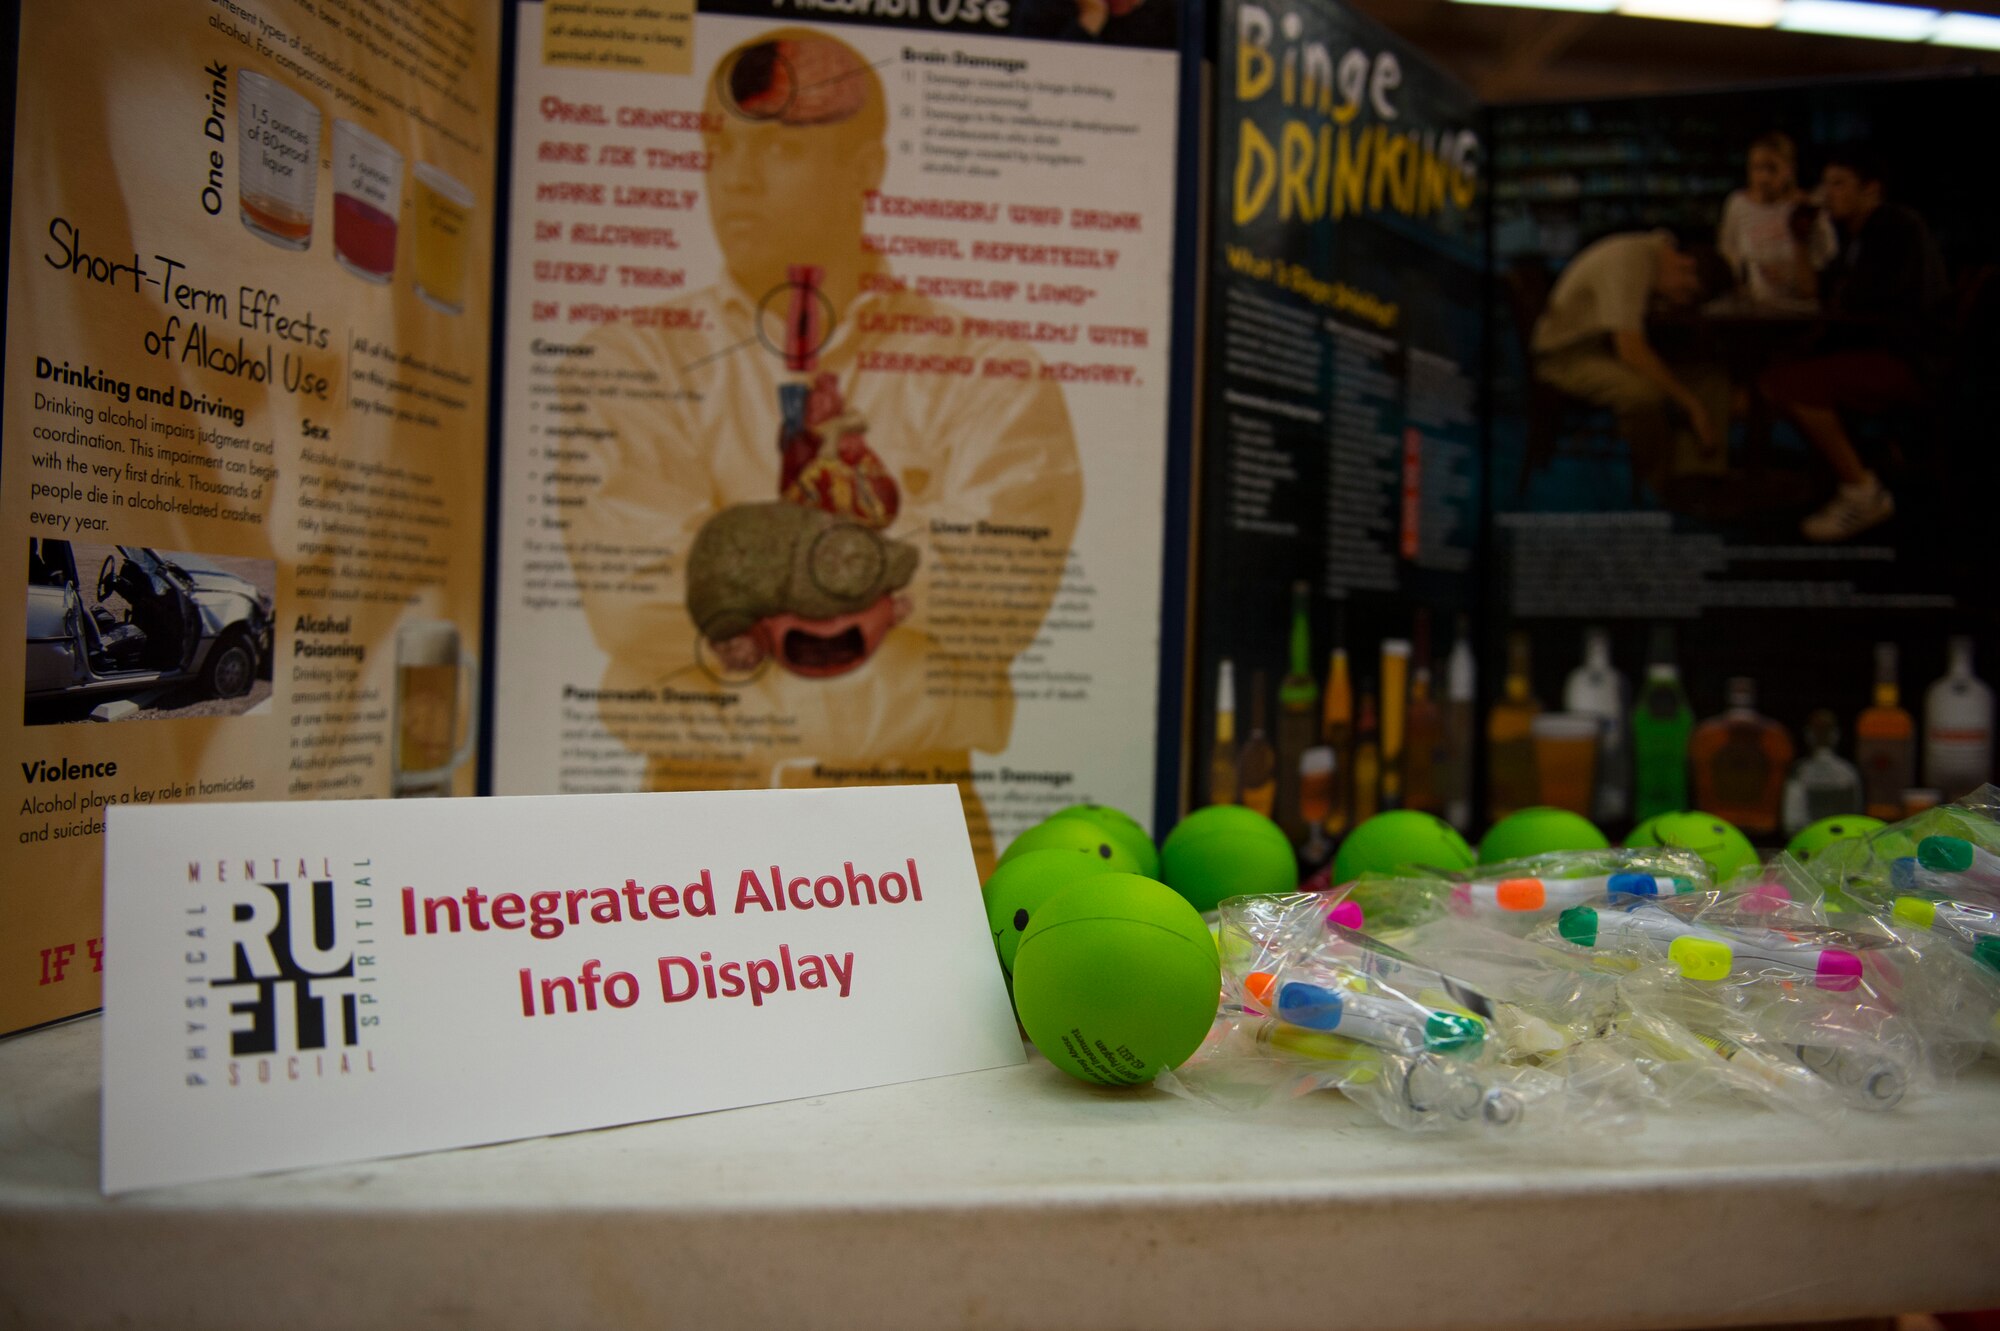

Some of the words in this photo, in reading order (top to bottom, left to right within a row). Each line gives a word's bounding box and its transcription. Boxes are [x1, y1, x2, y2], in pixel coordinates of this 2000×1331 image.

[208, 13, 254, 49] alcohol.
[256, 38, 274, 59] For
[276, 53, 333, 92] comparison
[259, 17, 287, 44] types
[901, 47, 947, 65] Brain
[953, 50, 1028, 73] Damage
[1236, 3, 1404, 125] Binge
[204, 59, 228, 144] Drink
[248, 127, 261, 143] of
[251, 104, 268, 125] 1.5
[270, 118, 311, 146] ounces
[202, 149, 224, 216] One
[261, 152, 294, 179] liquor
[1232, 116, 1480, 228] DRINKING
[44, 216, 228, 320] Short-Term
[238, 286, 331, 350] Effects
[144, 316, 181, 361] of
[181, 321, 274, 386] Alcohol
[283, 351, 329, 401] Use
[530, 337, 596, 357] Cancer
[35, 355, 131, 403] Drinking
[135, 385, 175, 407] and
[179, 390, 246, 427] Driving
[34, 391, 94, 425] Drinking
[98, 406, 148, 431] alcohol
[150, 417, 196, 440] impairs
[197, 426, 250, 453] judgment
[252, 438, 274, 456] and
[301, 417, 331, 442] Sex
[31, 451, 62, 471] with
[66, 453, 88, 475] the
[92, 462, 122, 484] very
[125, 463, 148, 483] first
[150, 468, 185, 488] drink.
[188, 474, 249, 500] Thousands
[251, 485, 264, 501] of
[32, 426, 126, 454] coordination.
[129, 437, 154, 459] This
[156, 442, 223, 470] impairment
[225, 459, 247, 474] can
[249, 458, 279, 483] begin
[30, 510, 72, 532] every
[74, 514, 110, 533] year.
[31, 481, 83, 504] people
[87, 484, 109, 504] die
[112, 490, 124, 506] in
[127, 490, 219, 519] alcohol-related
[221, 505, 263, 525] crashes
[929, 518, 973, 536] Liver
[975, 519, 1053, 542] Damage
[294, 613, 351, 634] Alcohol
[294, 639, 364, 663] Poisoning
[292, 664, 333, 684] Drinking
[660, 685, 742, 710] Damage
[21, 757, 118, 784] Violence
[999, 767, 1076, 788] Damage
[19, 791, 78, 818] Alcohol
[80, 788, 118, 815] plays
[119, 792, 131, 805] a
[133, 785, 156, 806] key
[157, 781, 183, 800] role
[184, 780, 196, 797] in
[198, 774, 256, 796] homicides
[18, 821, 50, 844] and
[52, 816, 107, 840] suicides
[187, 856, 333, 885] MENTAL
[400, 868, 718, 941] Integrated
[732, 857, 924, 915] Alcohol
[210, 879, 355, 979] RU
[353, 857, 381, 1028] SPIRITUAL
[38, 942, 76, 987] IF
[518, 958, 640, 1018] Info
[656, 943, 855, 1007] Display
[184, 904, 209, 1088] PHYSICAL
[209, 975, 359, 1058] FIT
[228, 1049, 376, 1087] SOCIAL
[1071, 1028, 1099, 1067] Treatment
